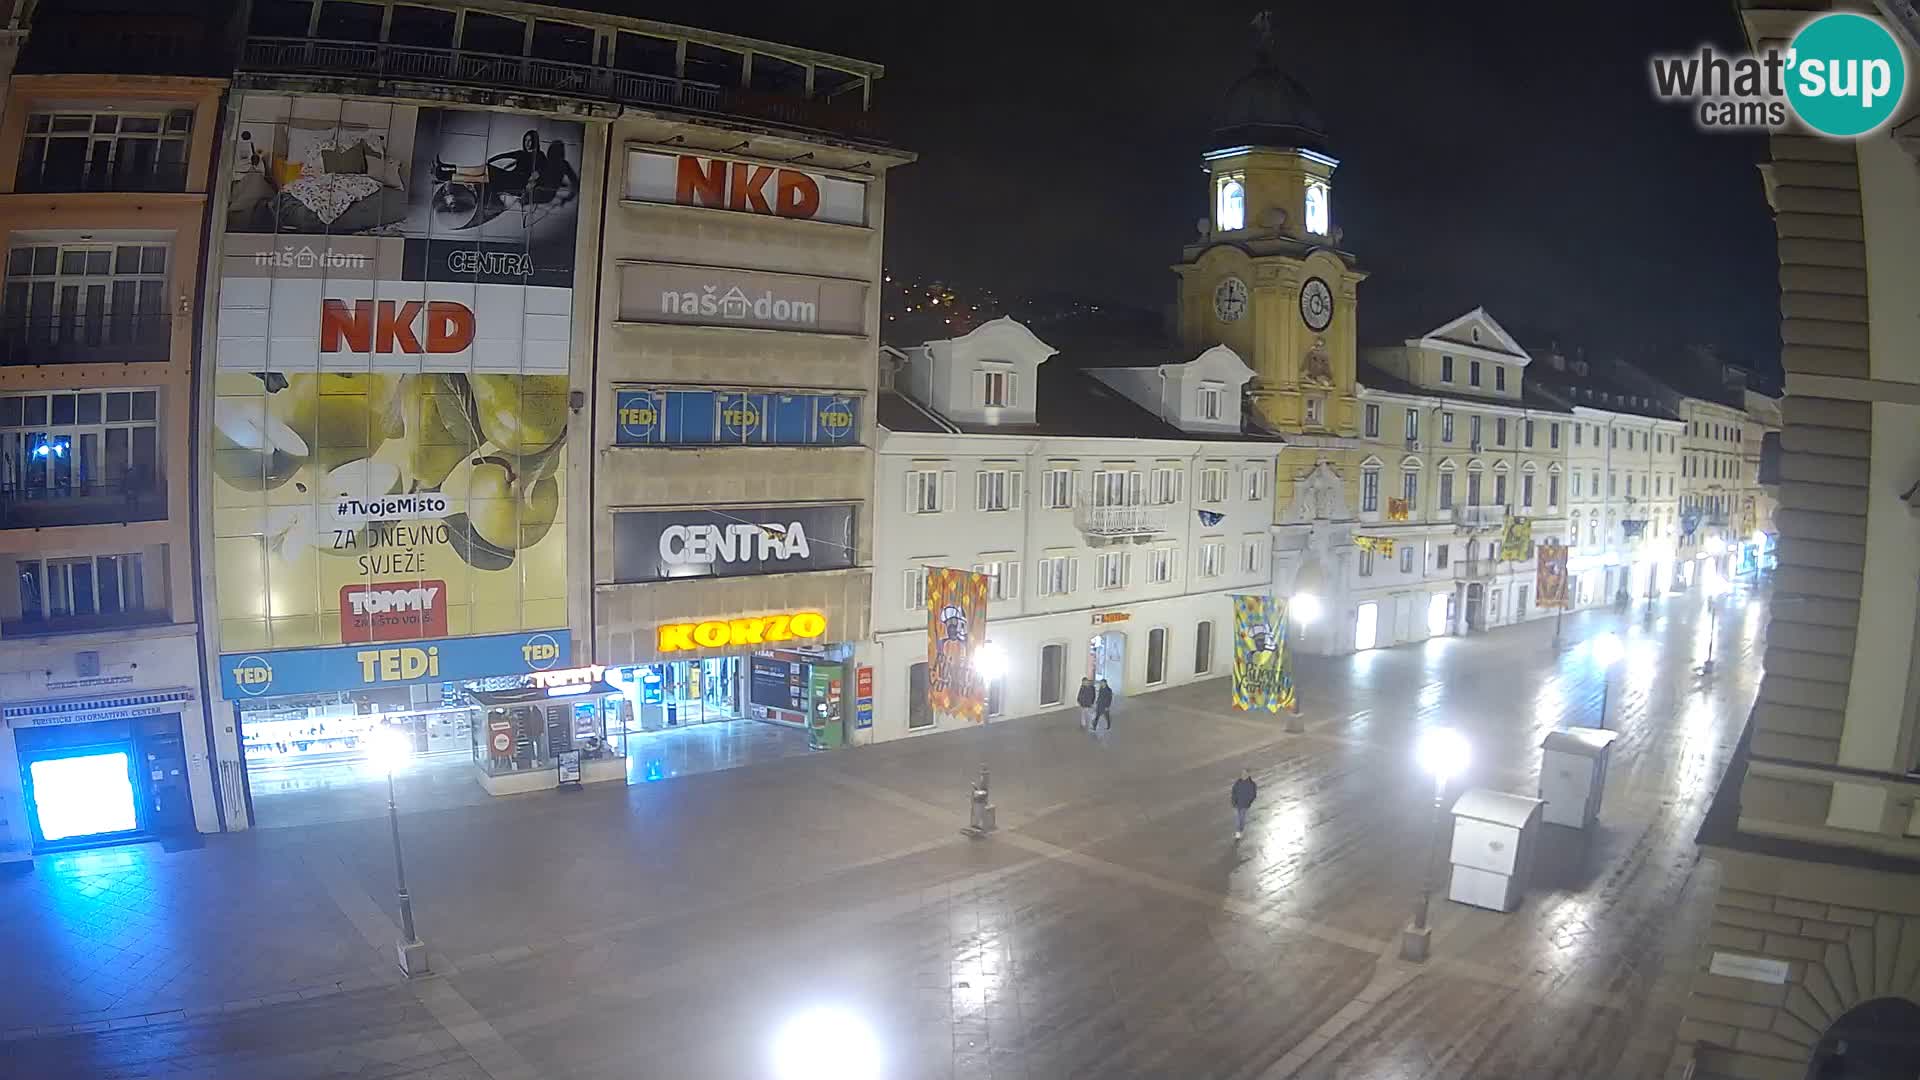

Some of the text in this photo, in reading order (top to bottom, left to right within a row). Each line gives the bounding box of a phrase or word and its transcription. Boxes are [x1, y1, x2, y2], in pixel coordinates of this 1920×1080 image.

[675, 155, 821, 219] NKD
[255, 246, 366, 269] naš dom
[447, 250, 535, 276] CENTRA
[661, 285, 816, 323] naš dom
[320, 298, 477, 353] NKD
[619, 409, 657, 427] TEDi
[723, 410, 760, 427] TEDi
[820, 412, 853, 429] TEDi
[338, 497, 446, 518] #TvojeMisto
[333, 524, 451, 549] ZA DNEVNO
[659, 521, 810, 564] CENTRA
[359, 548, 425, 576] SVJEŽE
[348, 588, 438, 615] TOMMY
[657, 612, 827, 652] KORZO
[232, 643, 560, 684] TEDi TEDi TEDi
